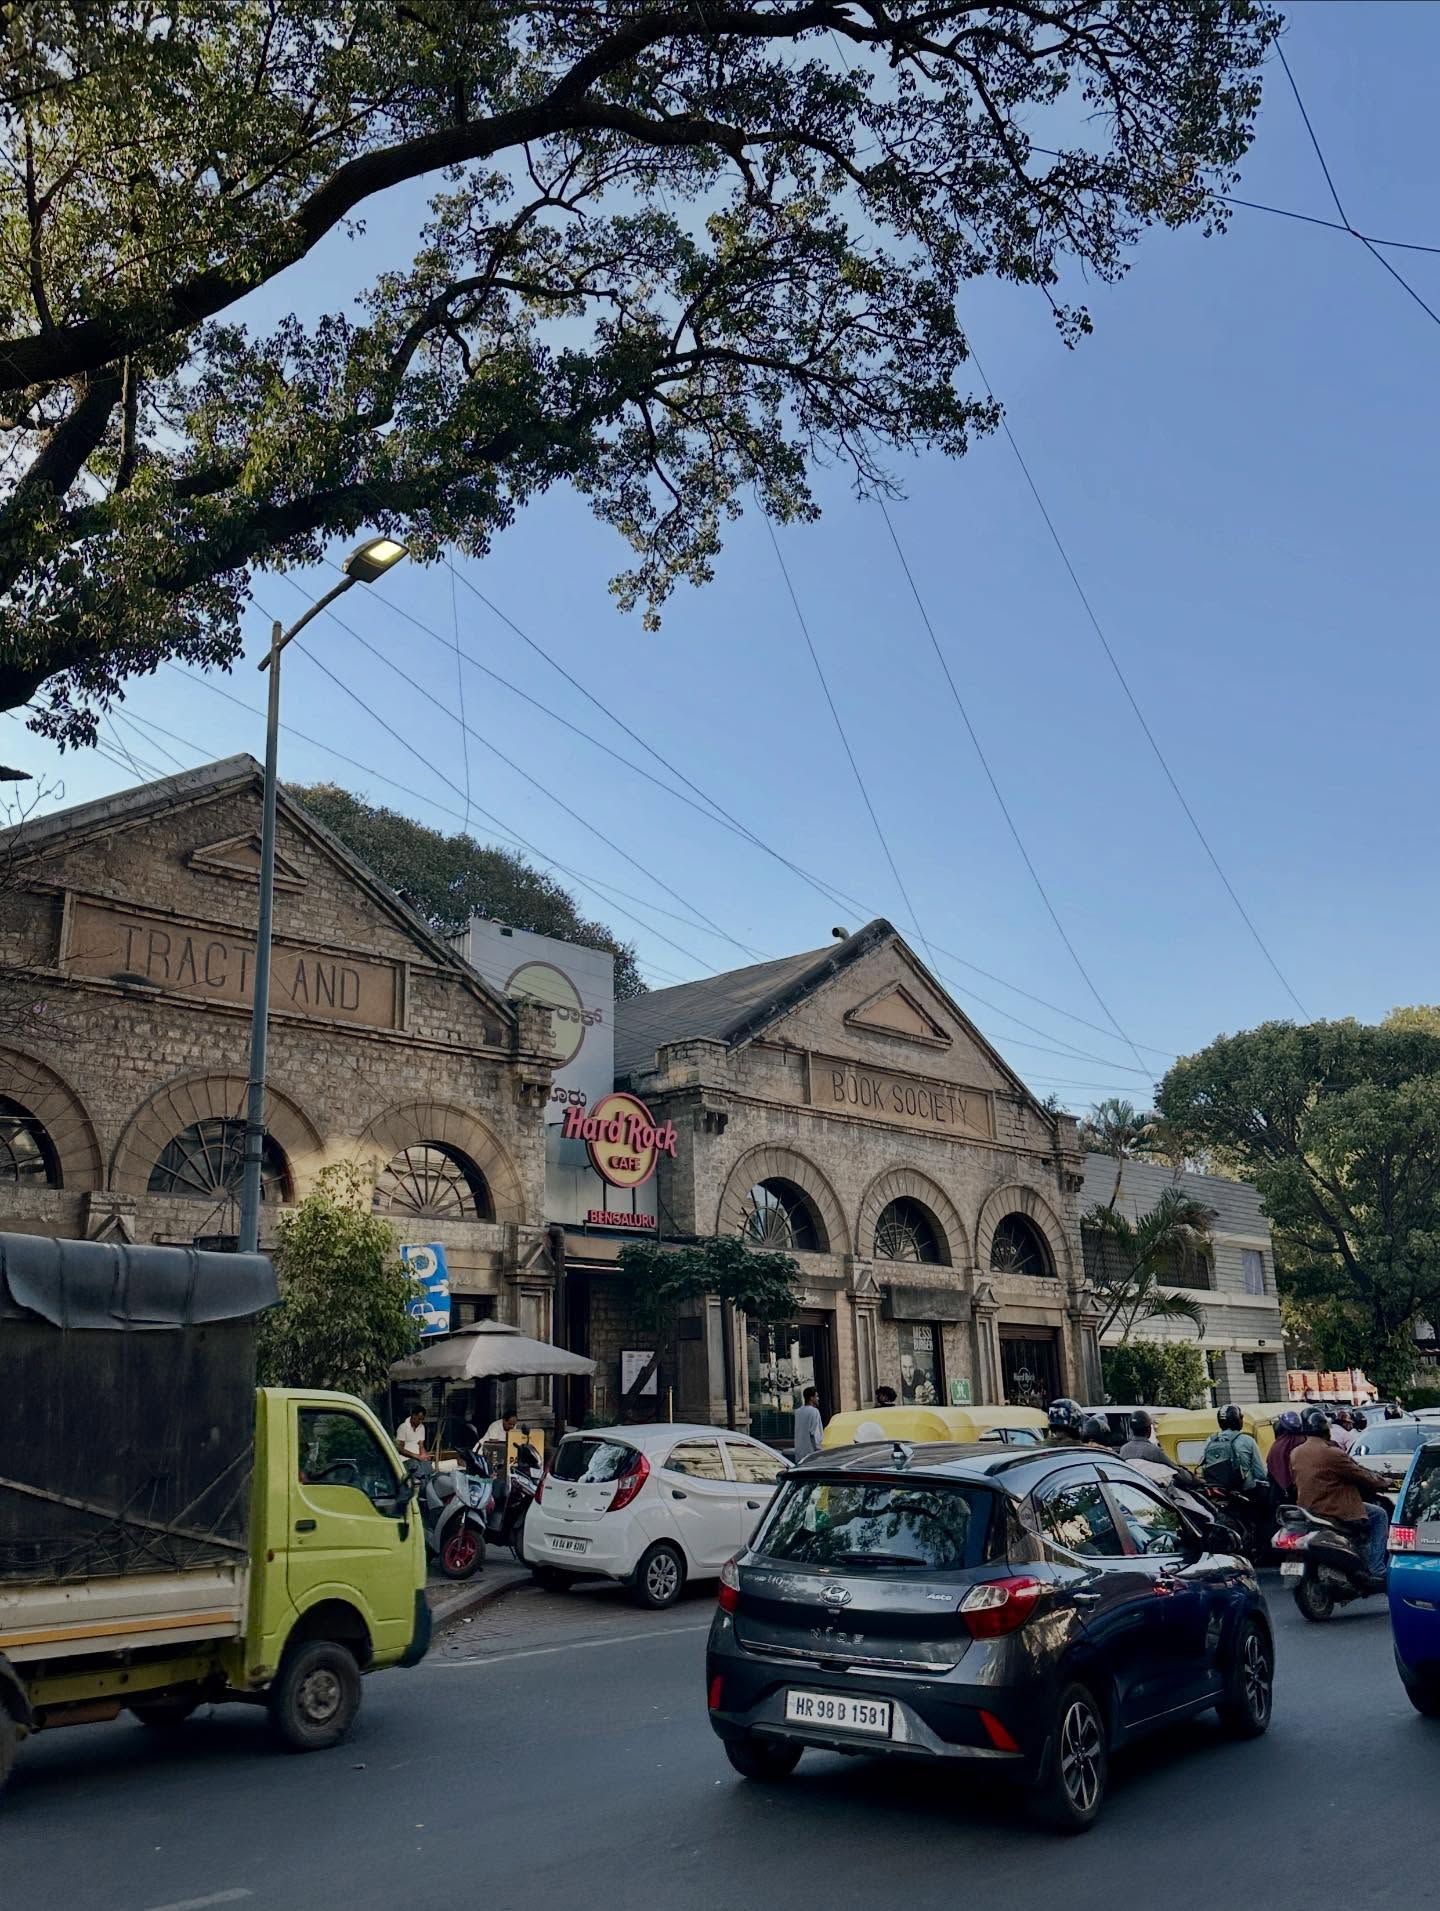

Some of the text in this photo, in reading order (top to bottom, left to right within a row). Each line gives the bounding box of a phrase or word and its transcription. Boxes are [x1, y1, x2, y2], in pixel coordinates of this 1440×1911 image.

[117, 922, 361, 1012] TRACT AND
[831, 1071, 968, 1126] BOOK SOCIETY
[563, 1106, 679, 1158] Hard Rock
[609, 1156, 641, 1171] CAFE
[589, 1210, 656, 1228] BENGALURU
[796, 1697, 886, 1726] HR 98 B 1581
